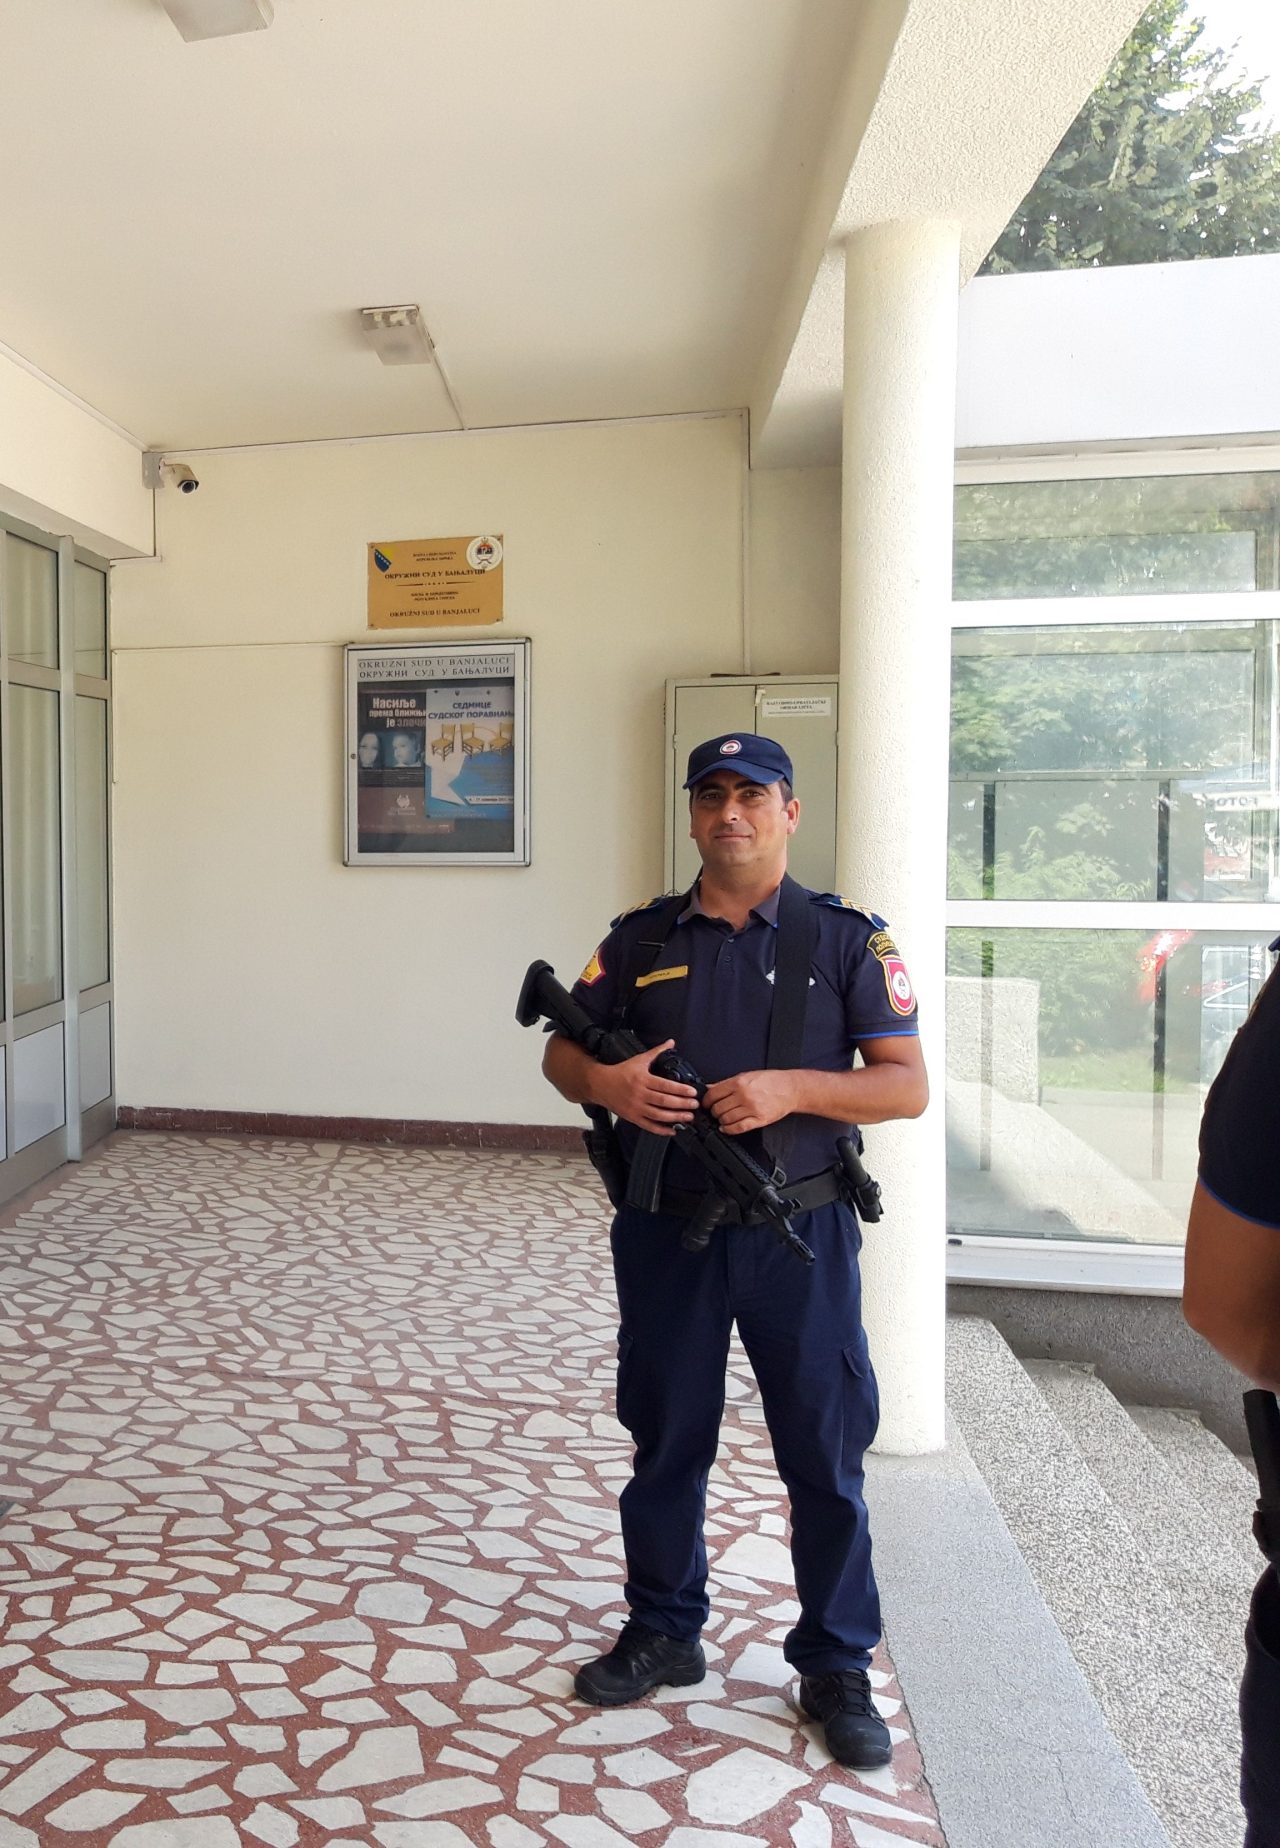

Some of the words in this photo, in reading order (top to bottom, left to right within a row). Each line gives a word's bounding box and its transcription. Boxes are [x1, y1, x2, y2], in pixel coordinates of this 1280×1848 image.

[411, 659, 432, 667] SUD
[449, 657, 509, 665] BANJALUCI
[359, 670, 408, 678] ОКРУЖНИ
[415, 669, 435, 677] СУД
[442, 668, 448, 676] У
[452, 666, 509, 675] БАЊАЛУЦИ
[372, 697, 416, 709] Насиље
[452, 701, 492, 710] СЕДМИЦЕ
[428, 711, 464, 720] СУДСКОГ
[466, 710, 513, 719] ПОРАВНАЊ
[385, 718, 396, 728] је
[396, 718, 426, 728] злочи
